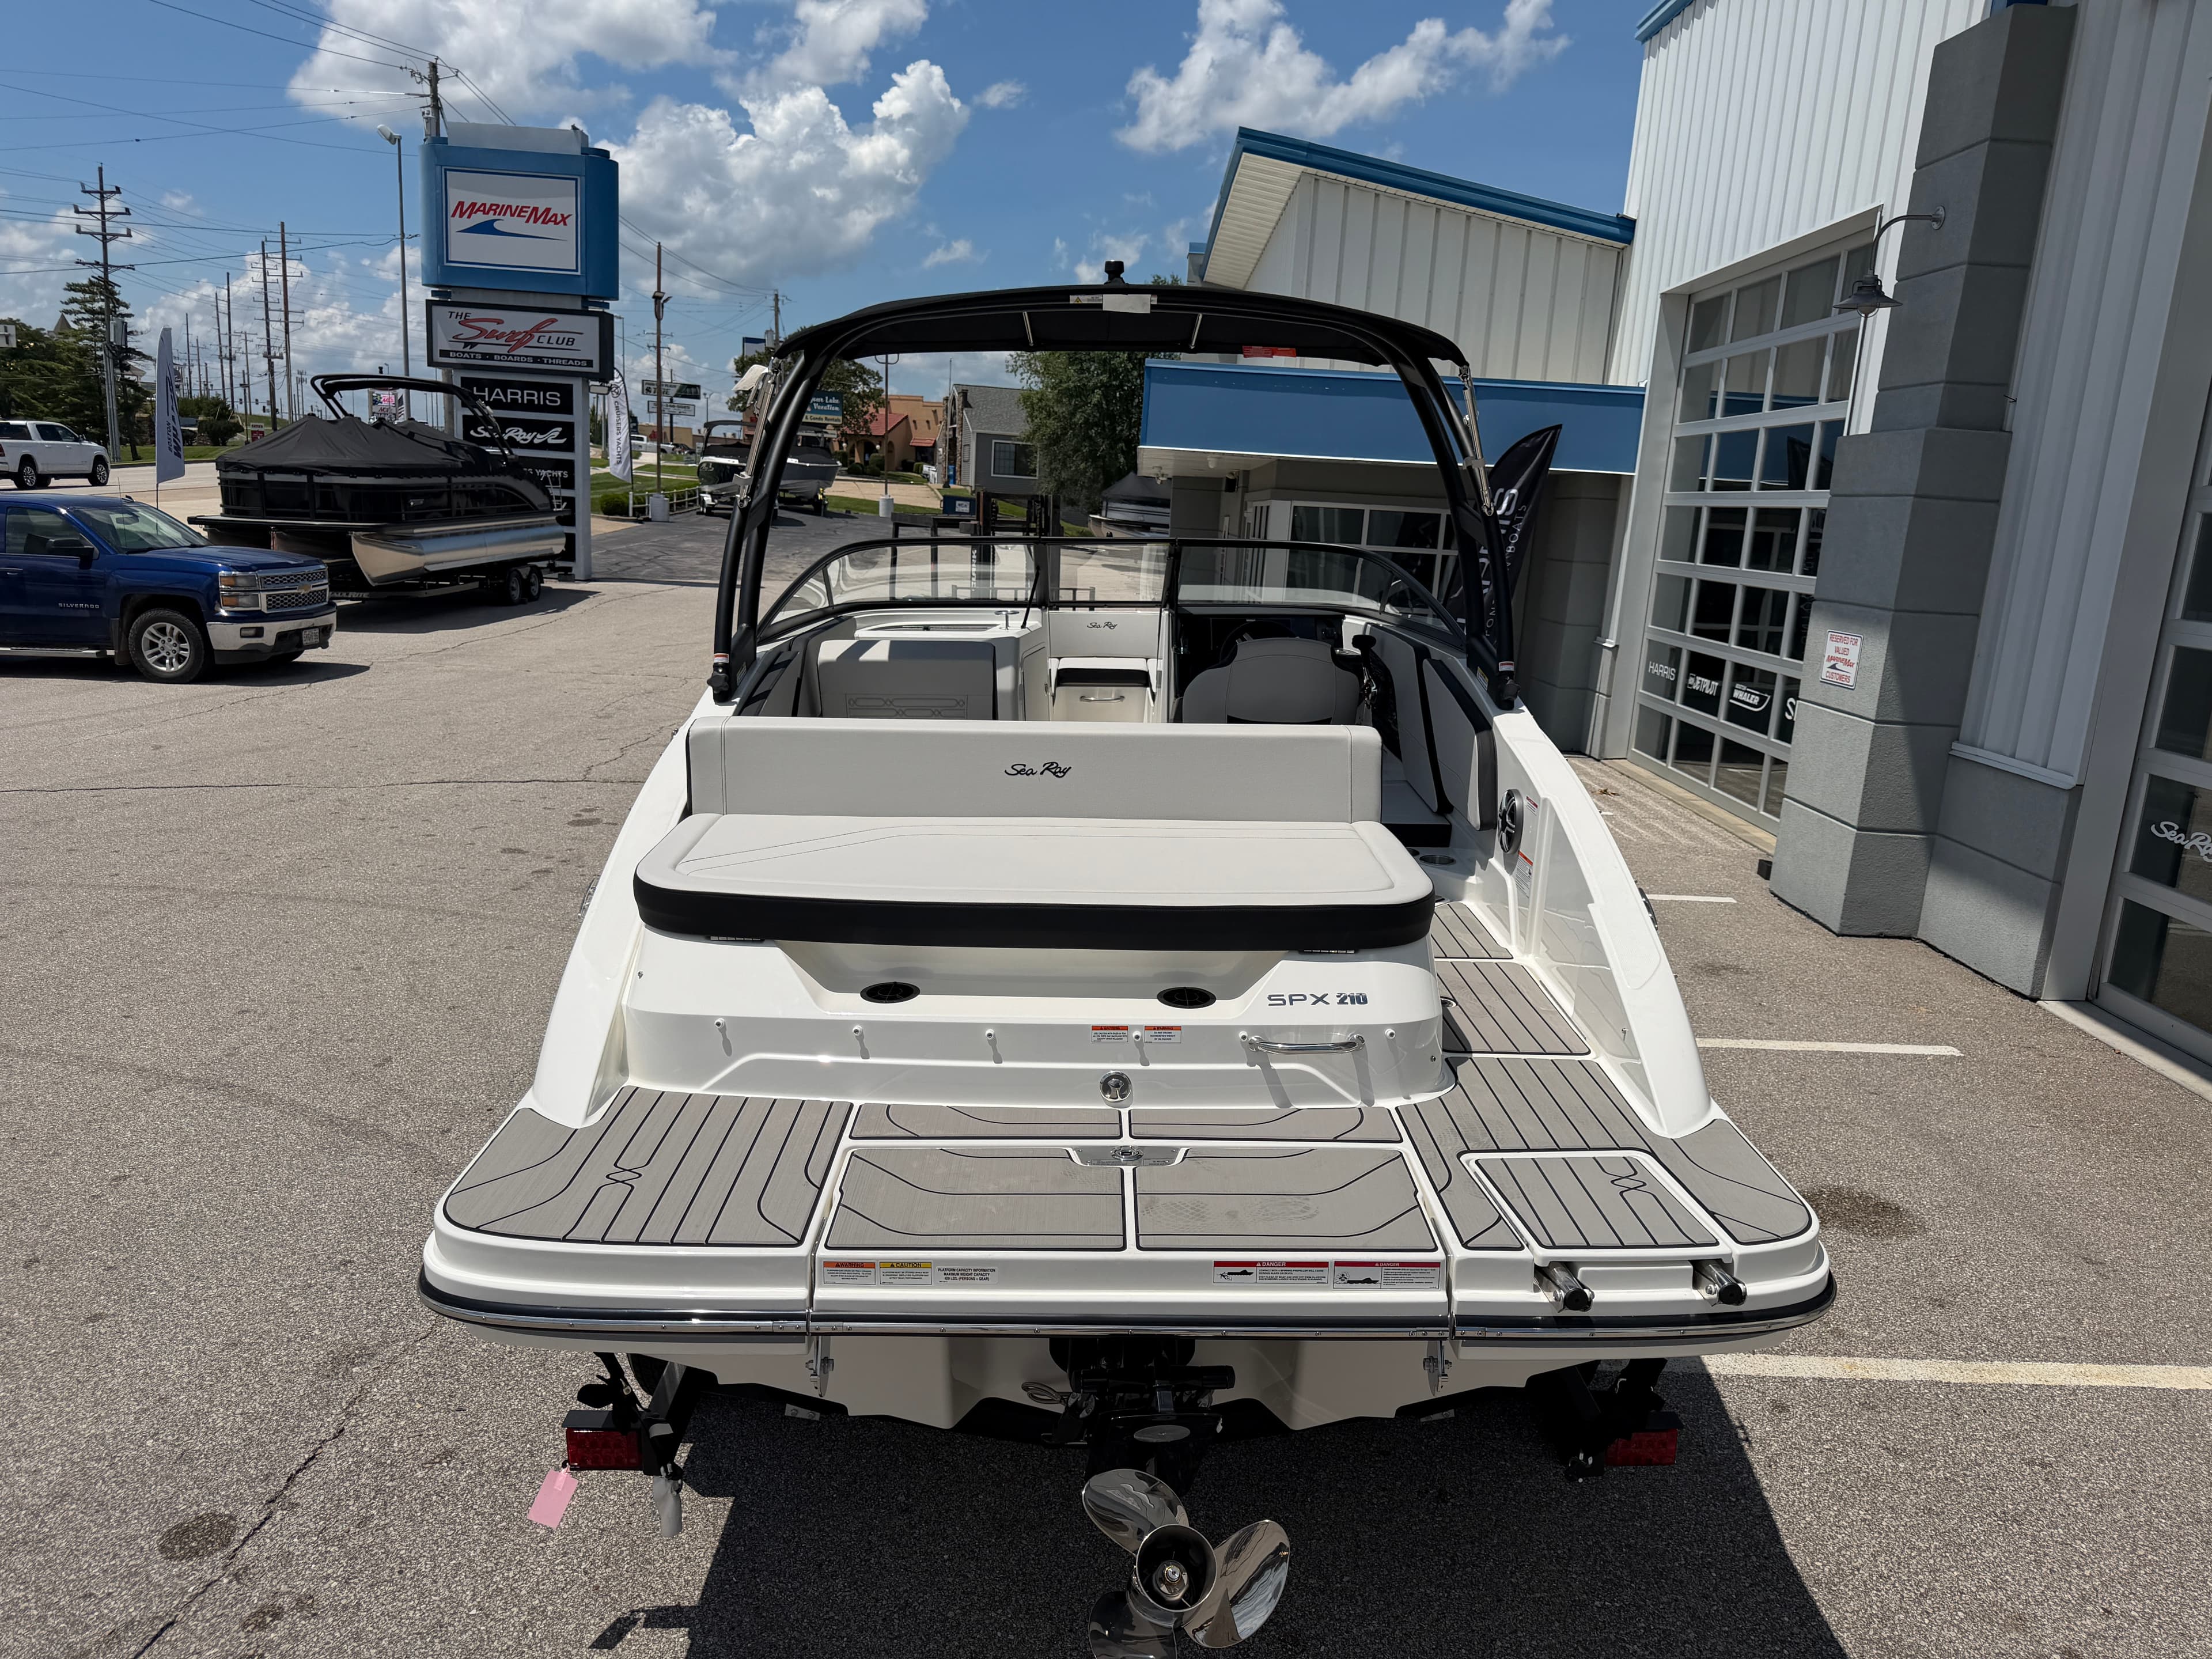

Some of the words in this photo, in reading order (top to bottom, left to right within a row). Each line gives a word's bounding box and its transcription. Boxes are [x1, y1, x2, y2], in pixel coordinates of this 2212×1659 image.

[448, 311, 471, 320] THE
[452, 318, 584, 353] Surf
[537, 335, 575, 346] CLUB
[449, 351, 482, 359] BOATS
[494, 354, 533, 363] BOARDS
[542, 358, 588, 367] THREADS
[473, 387, 561, 406] HARRIS
[614, 401, 622, 435] CRUISERS
[503, 427, 537, 444] Ray
[1506, 505, 1527, 553] BOATS
[1103, 622, 1118, 630] Ray
[1830, 634, 1849, 645] RESERVED
[1850, 637, 1858, 646] FOR
[1649, 661, 1676, 681] HARRIS
[1825, 671, 1851, 683] CUSTOMERS
[1732, 688, 1760, 706] WHALER
[1005, 763, 1037, 776] Sea
[1040, 762, 1072, 778] Ray
[2150, 821, 2188, 844] Sea
[1267, 993, 1330, 1006] SPX
[1336, 993, 1368, 1005] 210
